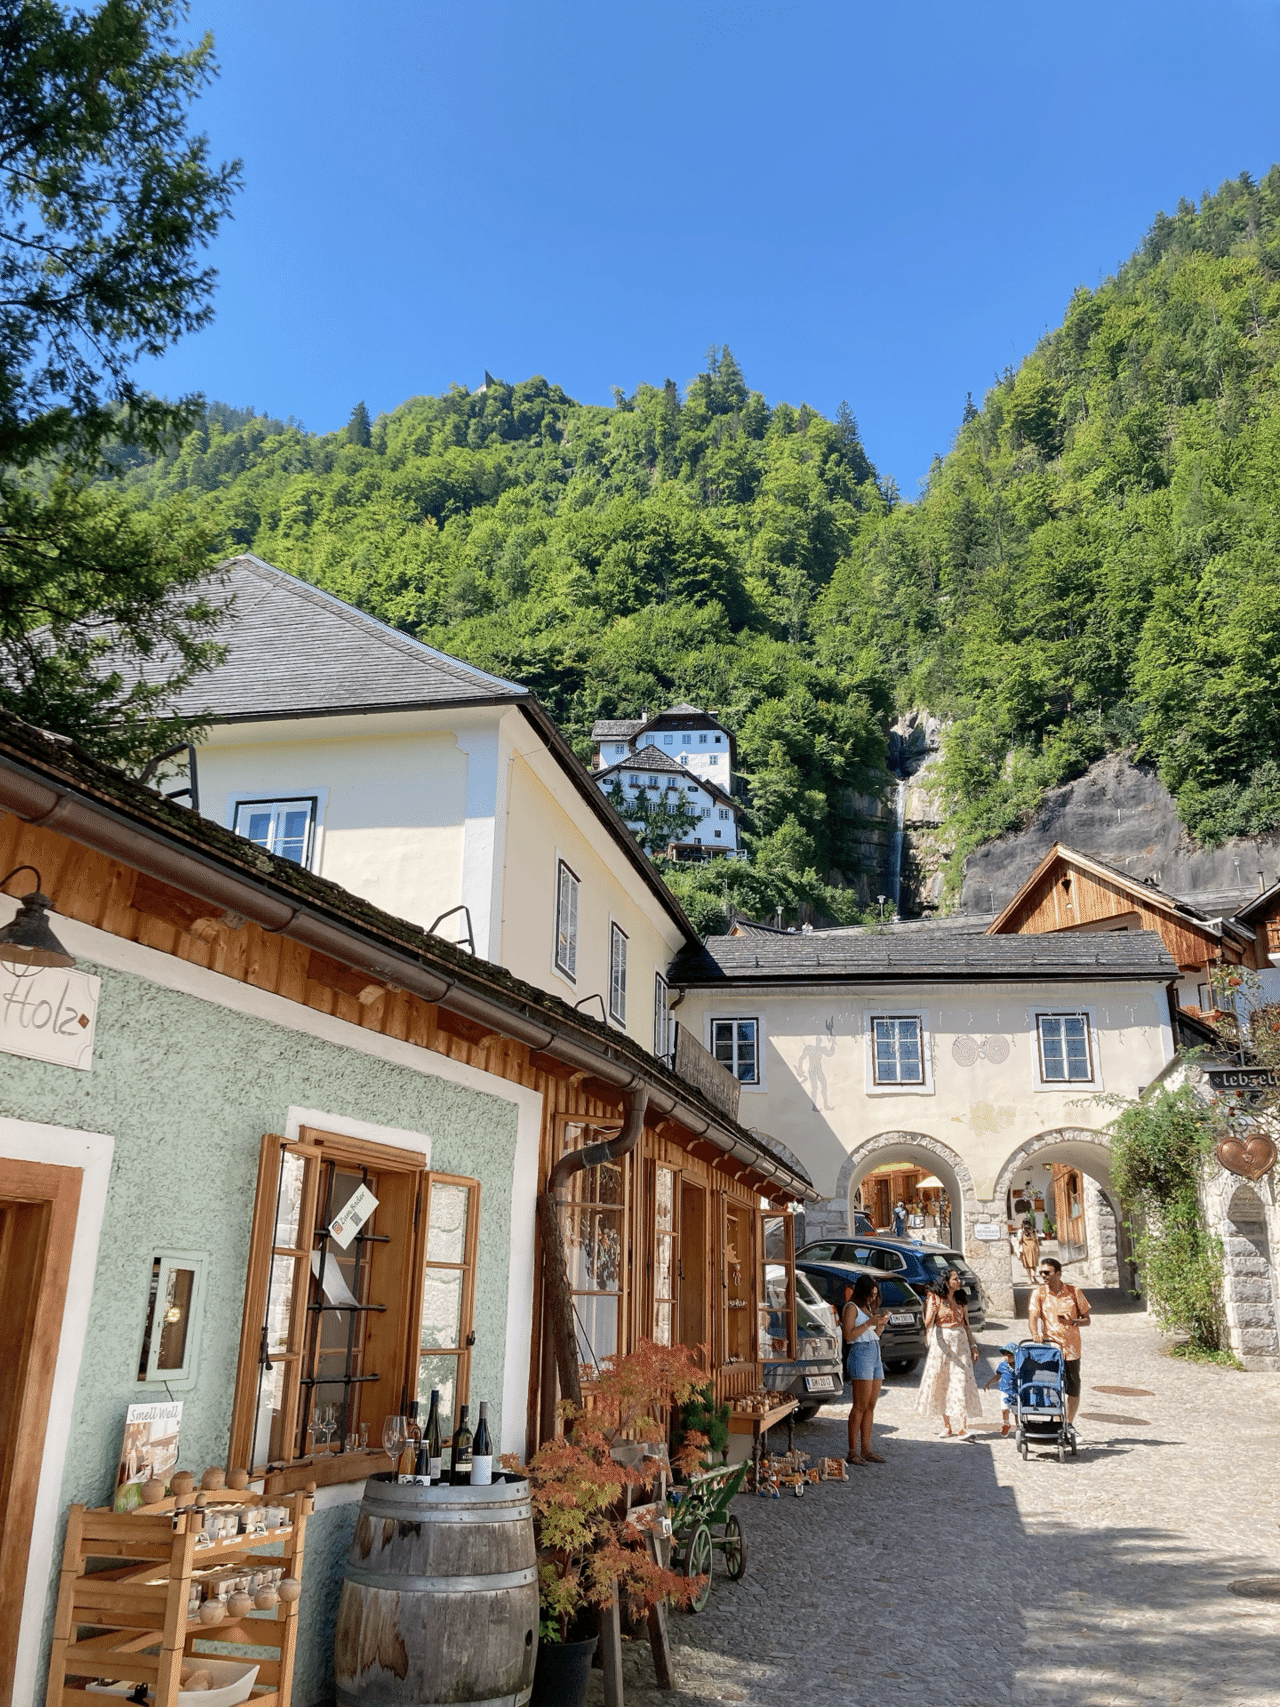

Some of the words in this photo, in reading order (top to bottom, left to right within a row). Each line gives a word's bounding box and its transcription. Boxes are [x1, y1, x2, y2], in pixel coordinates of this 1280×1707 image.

[3, 977, 79, 1036] Holz
[130, 1406, 158, 1422] Smell
[158, 1405, 179, 1419] Well
